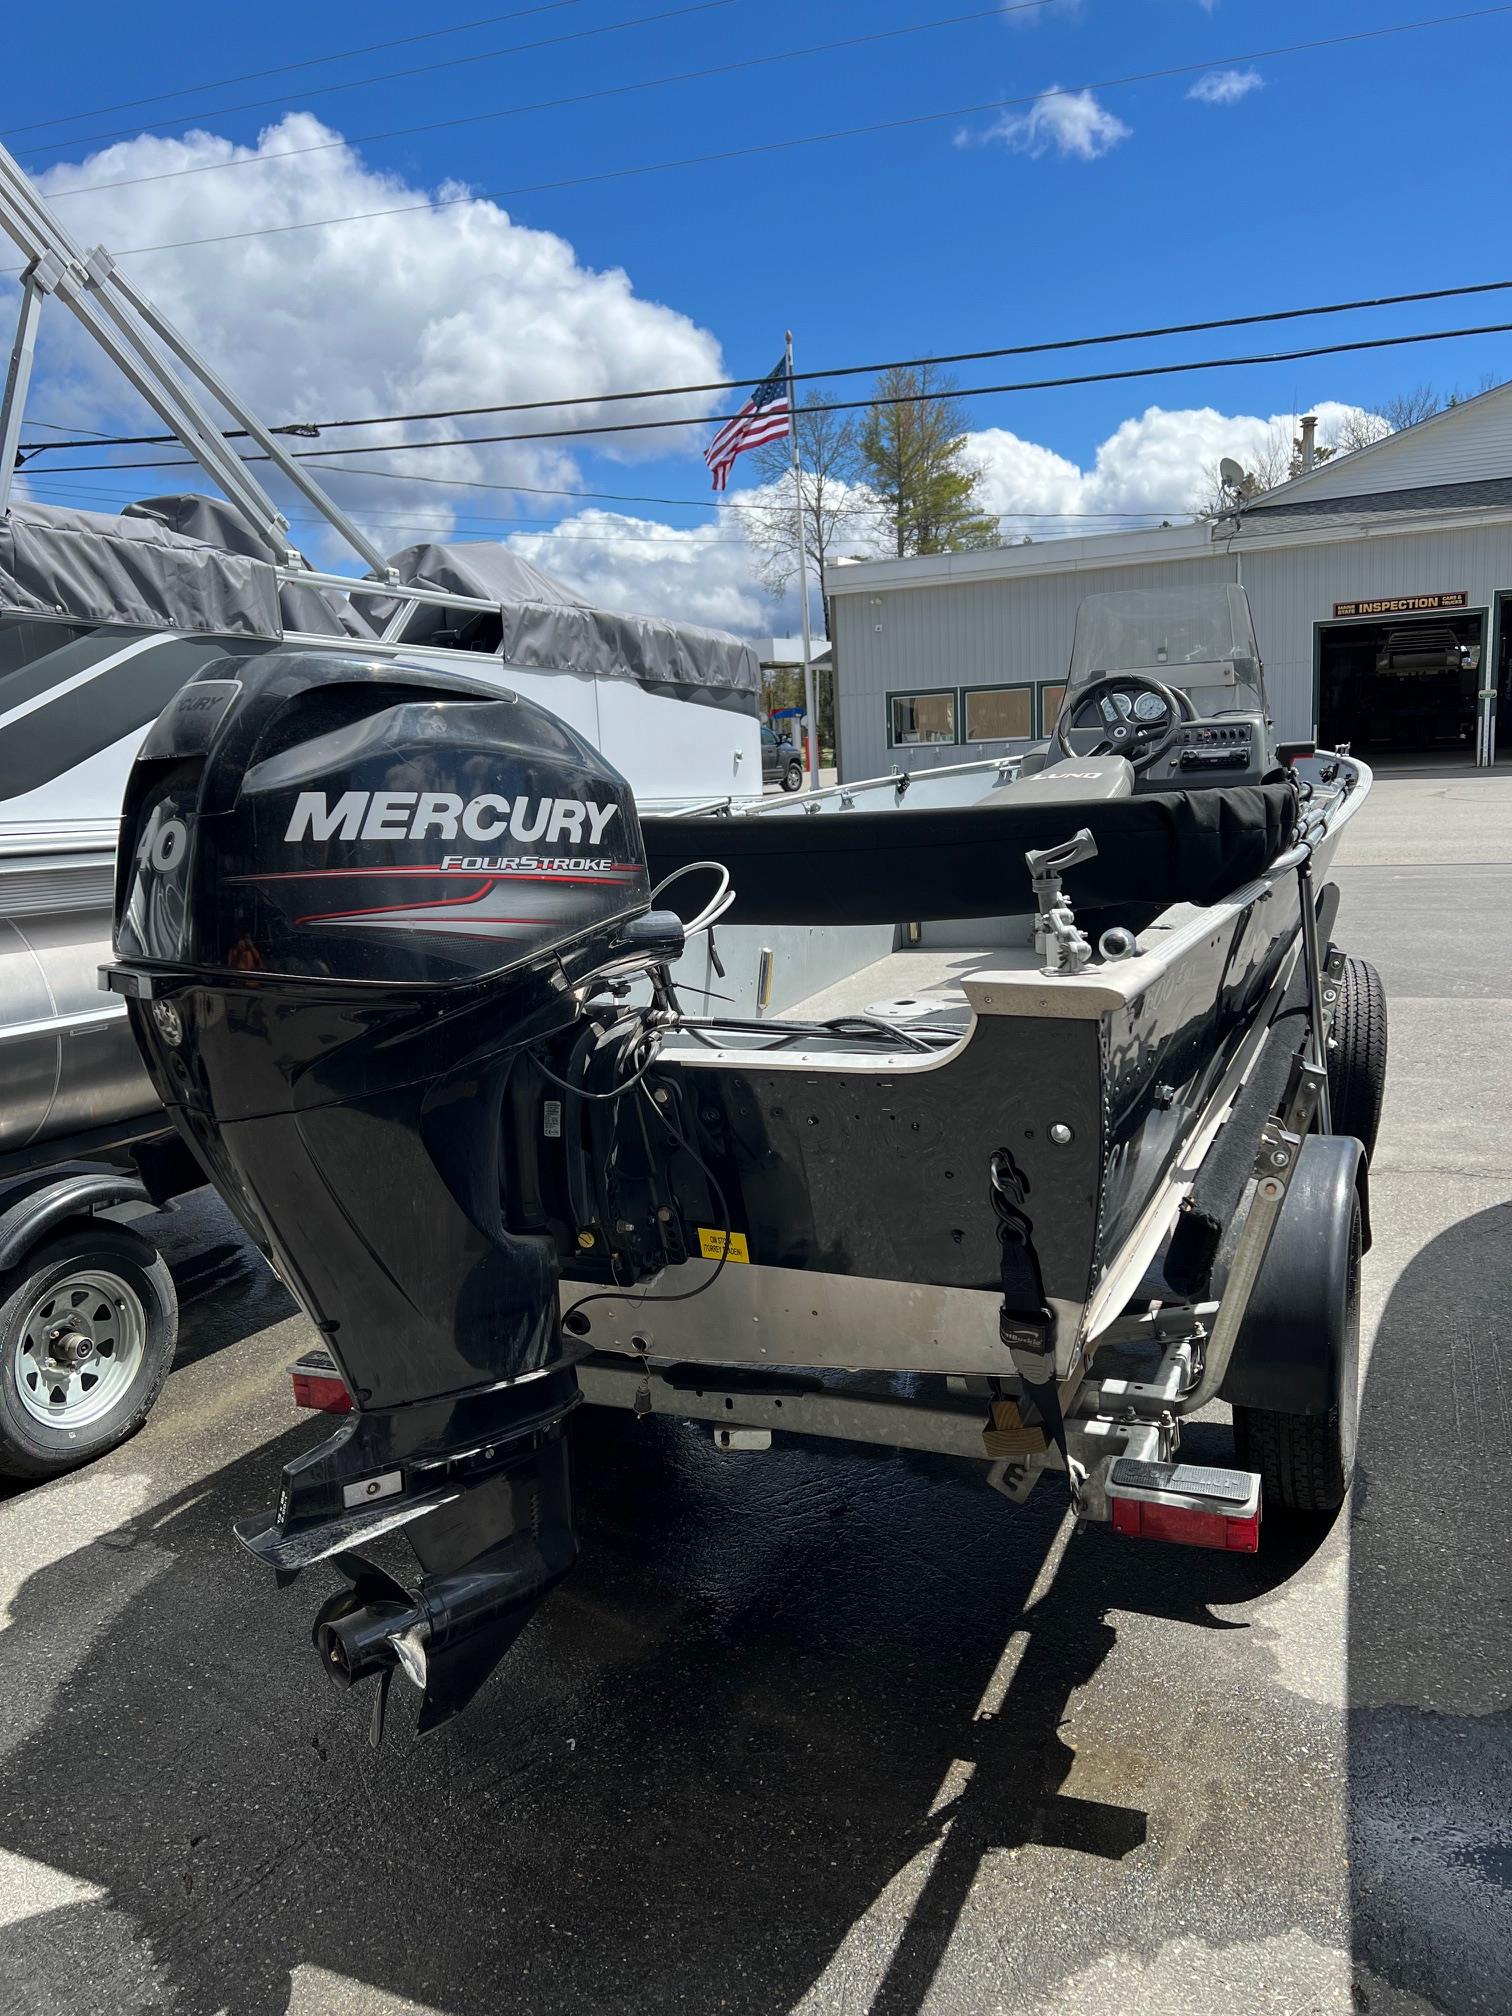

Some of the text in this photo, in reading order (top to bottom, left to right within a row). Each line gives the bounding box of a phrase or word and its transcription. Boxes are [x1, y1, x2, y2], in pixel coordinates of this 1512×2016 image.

[1359, 597, 1439, 614] INSPECTION
[177, 696, 225, 713] CURY
[284, 791, 619, 845] MERCURY
[135, 804, 188, 874] 40
[439, 855, 612, 872] FOURSTROKE
